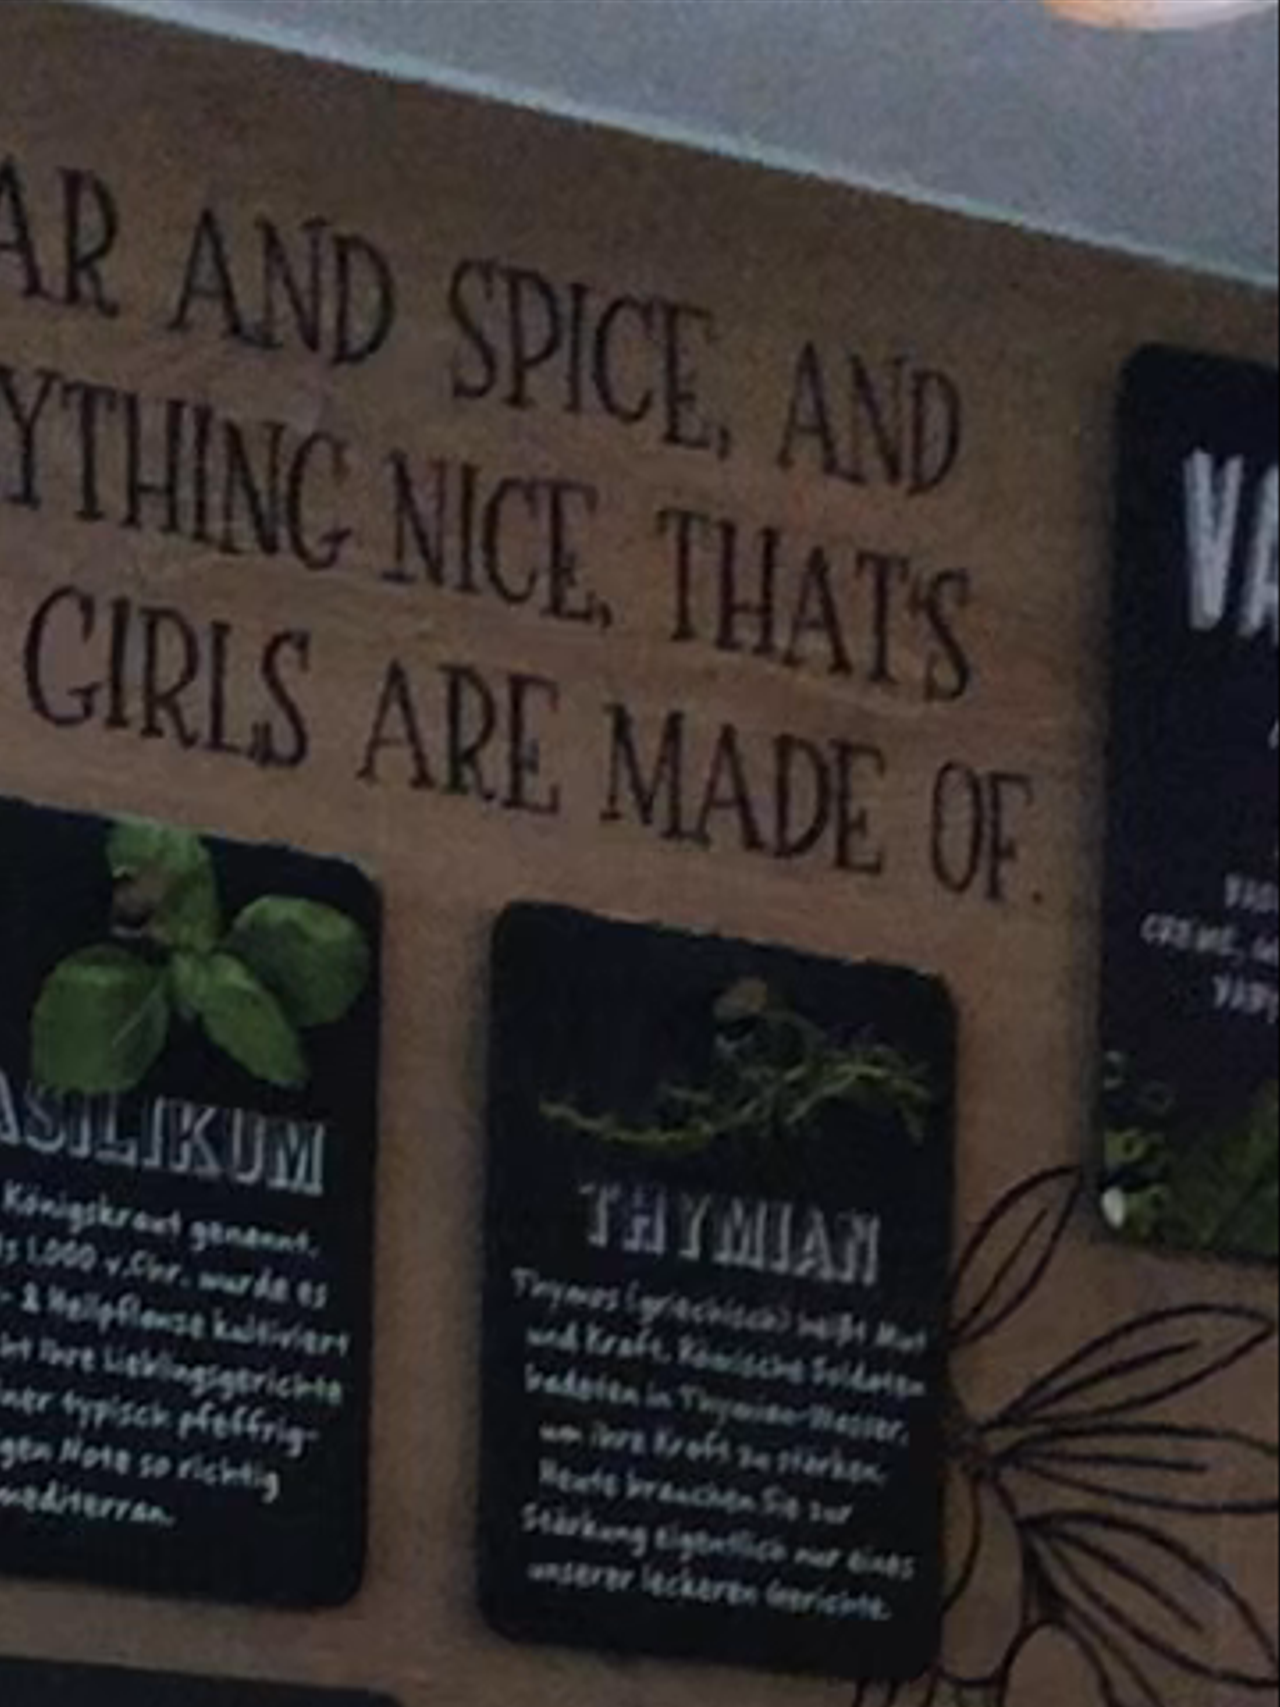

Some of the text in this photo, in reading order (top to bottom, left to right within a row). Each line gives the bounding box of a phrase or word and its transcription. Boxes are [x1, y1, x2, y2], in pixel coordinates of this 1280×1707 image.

[169, 207, 395, 366] AND
[446, 256, 732, 462] SPICE,
[776, 340, 962, 497] AND
[381, 449, 614, 630] NICE,
[21, 583, 309, 769] GIRLS
[356, 656, 561, 818] ARE
[600, 702, 886, 877] MADE
[1, 1177, 182, 1237] Königskraut
[578, 1181, 881, 1287] THYMIAN
[296, 1278, 328, 1309] es
[59, 1388, 172, 1430] typisch
[58, 1436, 131, 1475] Note
[138, 1453, 172, 1478] so
[177, 1455, 281, 1504] richtig
